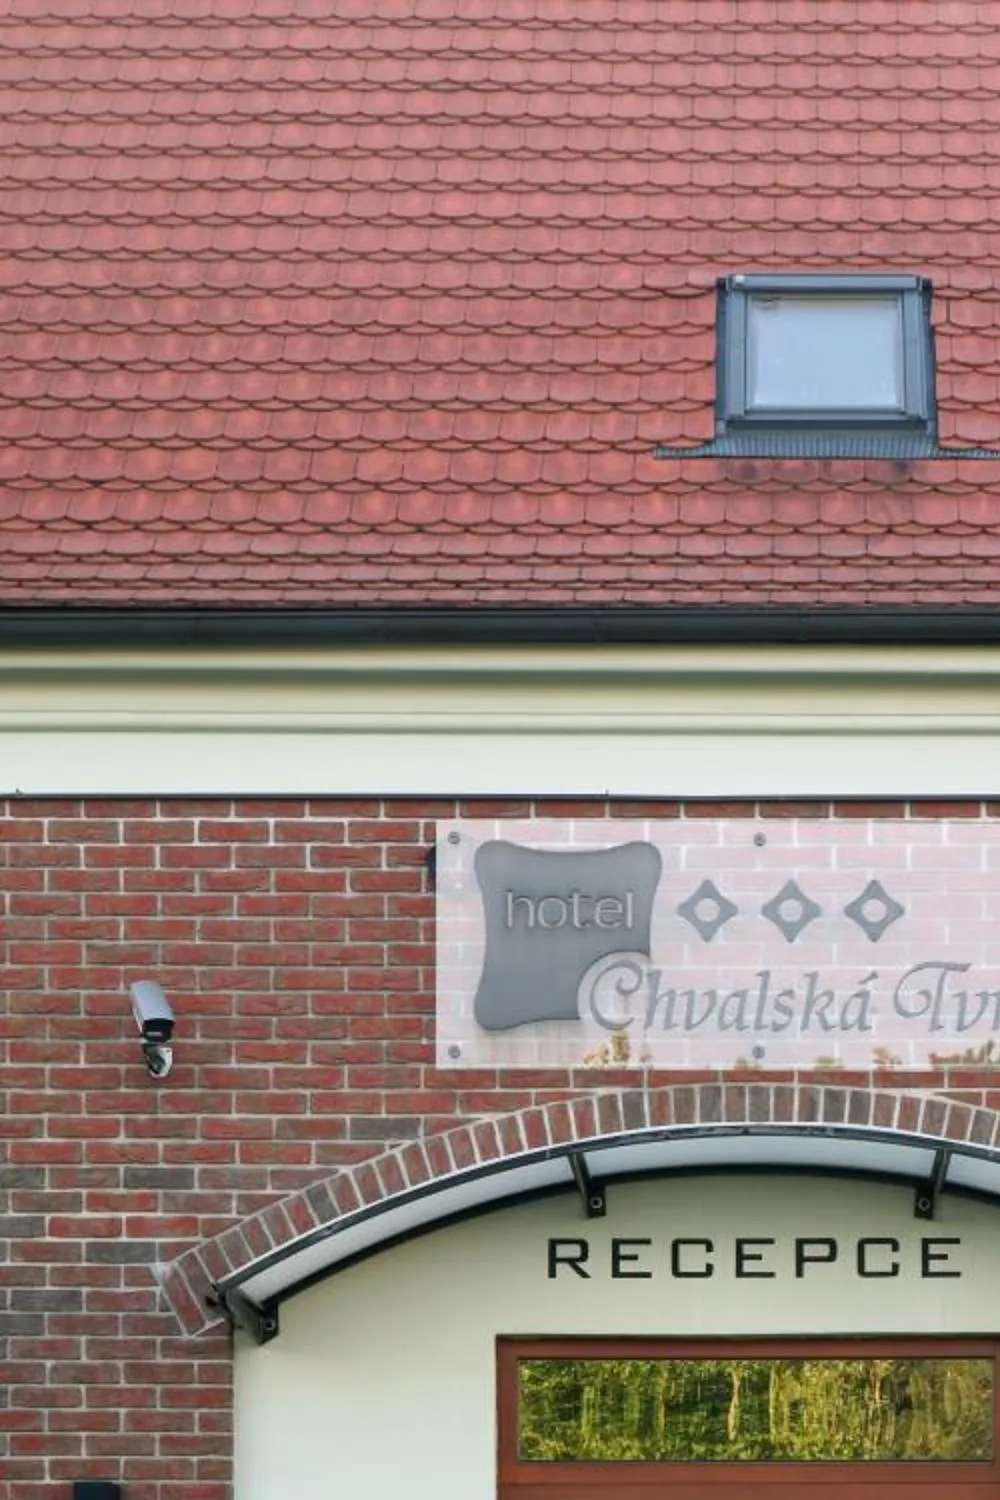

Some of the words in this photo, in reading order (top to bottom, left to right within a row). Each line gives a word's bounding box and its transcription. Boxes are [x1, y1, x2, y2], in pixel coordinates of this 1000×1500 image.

[504, 886, 634, 930] hotel
[589, 960, 879, 1032] Chvalská
[547, 1237, 962, 1279] RECEPCE
